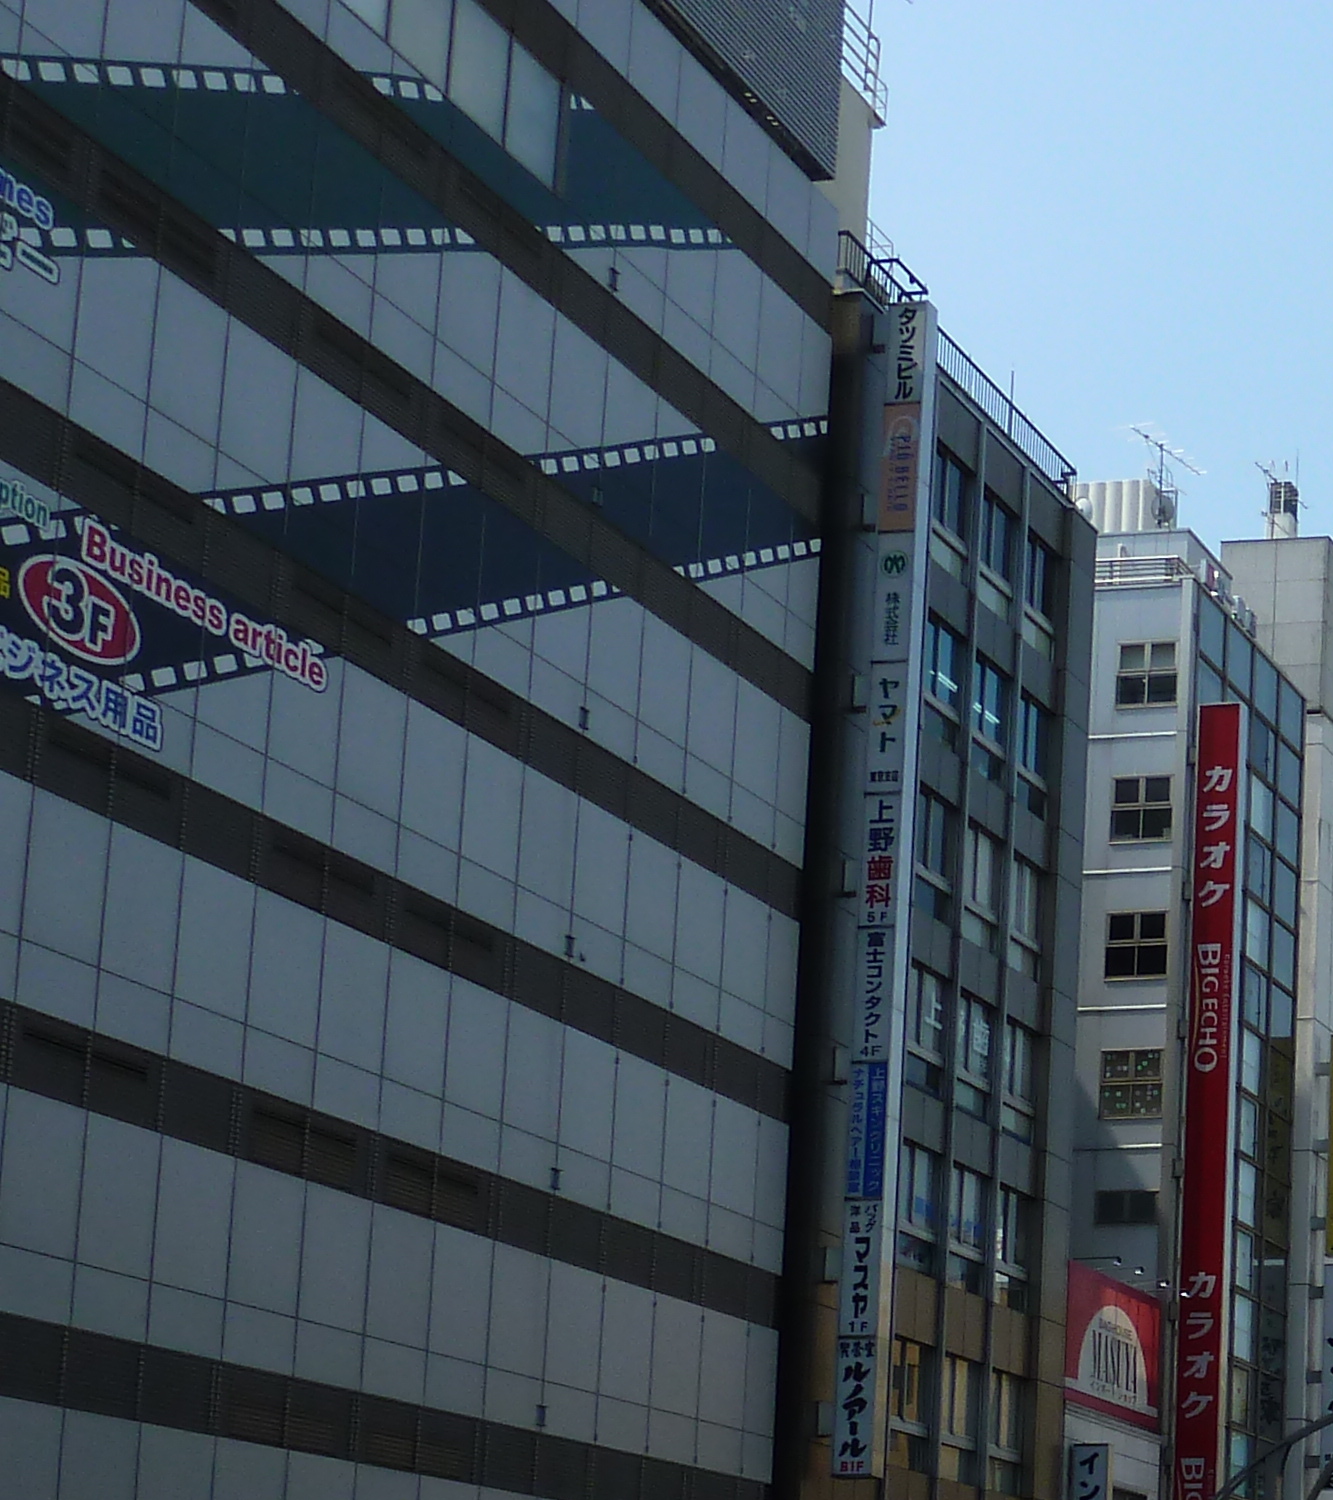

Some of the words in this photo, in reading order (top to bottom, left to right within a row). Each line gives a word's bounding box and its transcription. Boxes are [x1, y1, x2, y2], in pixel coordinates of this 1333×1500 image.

[893, 307, 917, 400] タツミビル
[45, 560, 114, 652] 3F
[82, 518, 227, 636] Business
[230, 612, 327, 692] article
[0, 625, 161, 750] ジネス用品
[878, 677, 900, 753] ヤマト
[866, 799, 895, 909] 上野歯科
[1198, 765, 1233, 908] カラオケ
[866, 911, 888, 923] 5F
[864, 932, 886, 1044] 富士コンタクト
[1197, 943, 1221, 993] BIG
[860, 1046, 883, 1057] 4F
[1194, 998, 1218, 1074] ECHO
[851, 1236, 871, 1319] マスヤ
[848, 1321, 869, 1333] 1F
[1180, 1271, 1217, 1419] カラオケ
[838, 1361, 872, 1458] ルノアール
[839, 1461, 864, 1473] B1F
